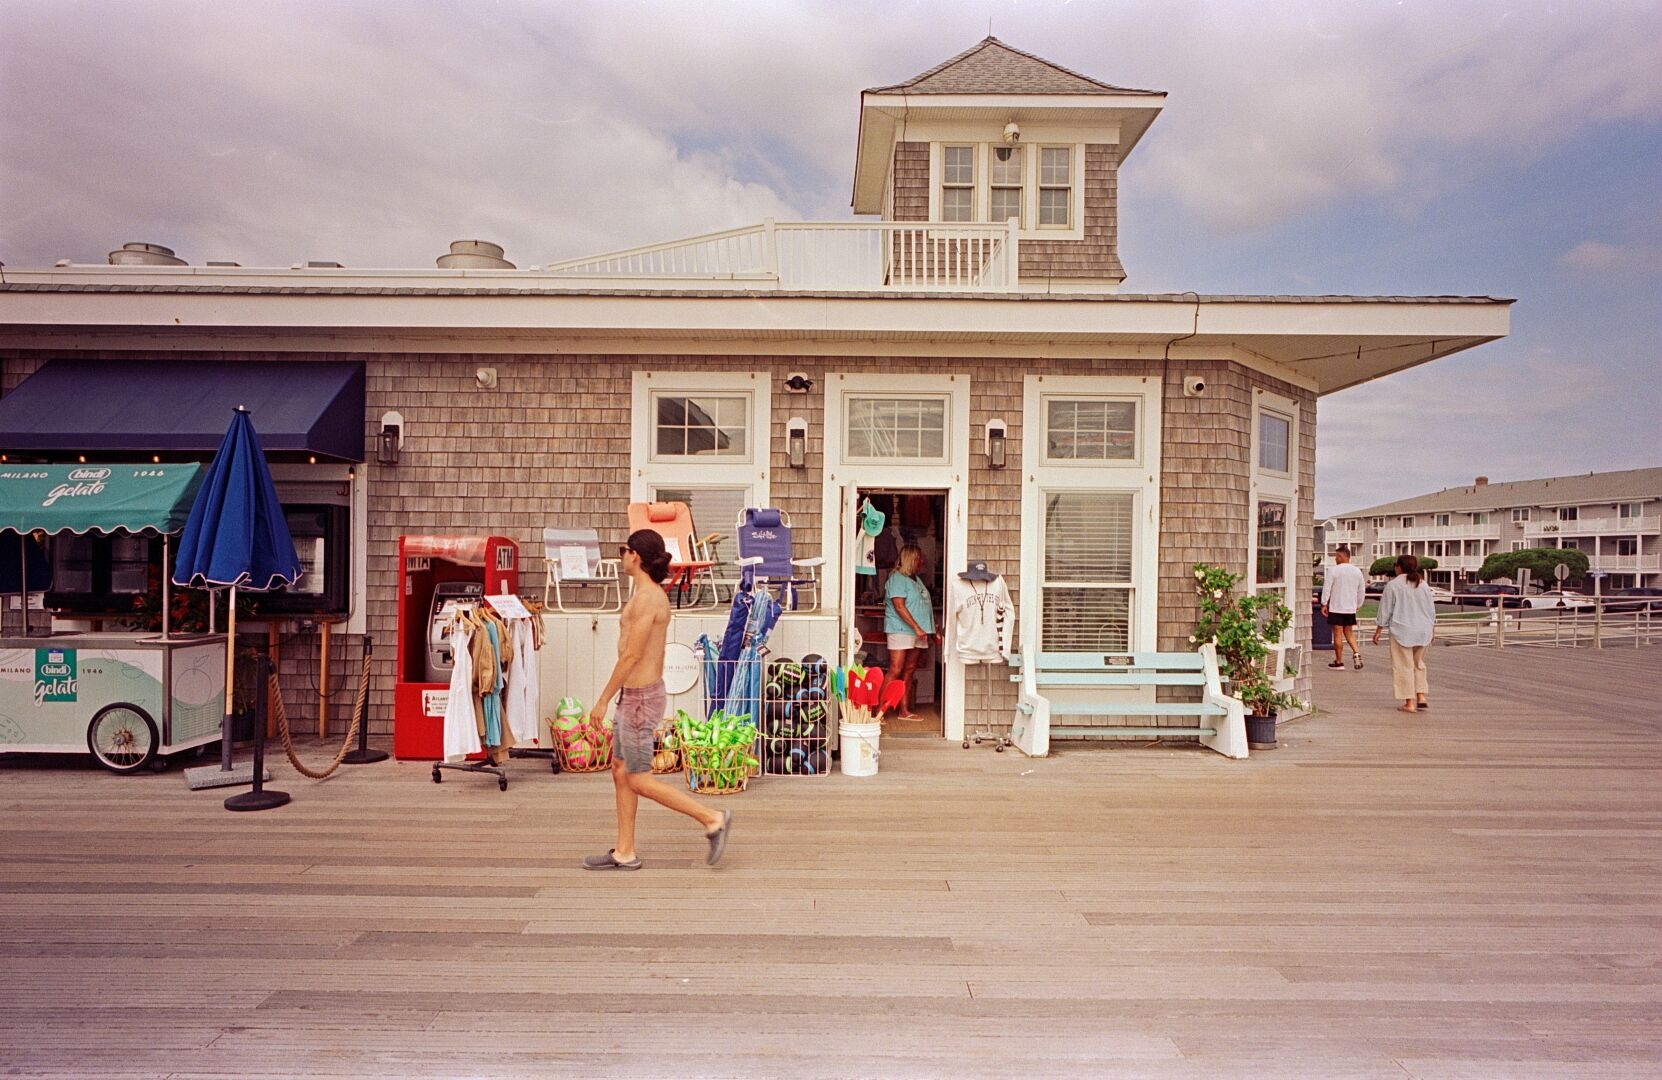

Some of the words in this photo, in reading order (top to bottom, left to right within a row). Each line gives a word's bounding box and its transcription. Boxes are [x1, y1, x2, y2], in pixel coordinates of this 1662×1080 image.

[0, 471, 48, 479] MILANO
[73, 469, 106, 479] bindi
[133, 469, 165, 478] 1946
[497, 548, 513, 569] ATM
[464, 585, 481, 593] ATM
[45, 665, 67, 675] bindi
